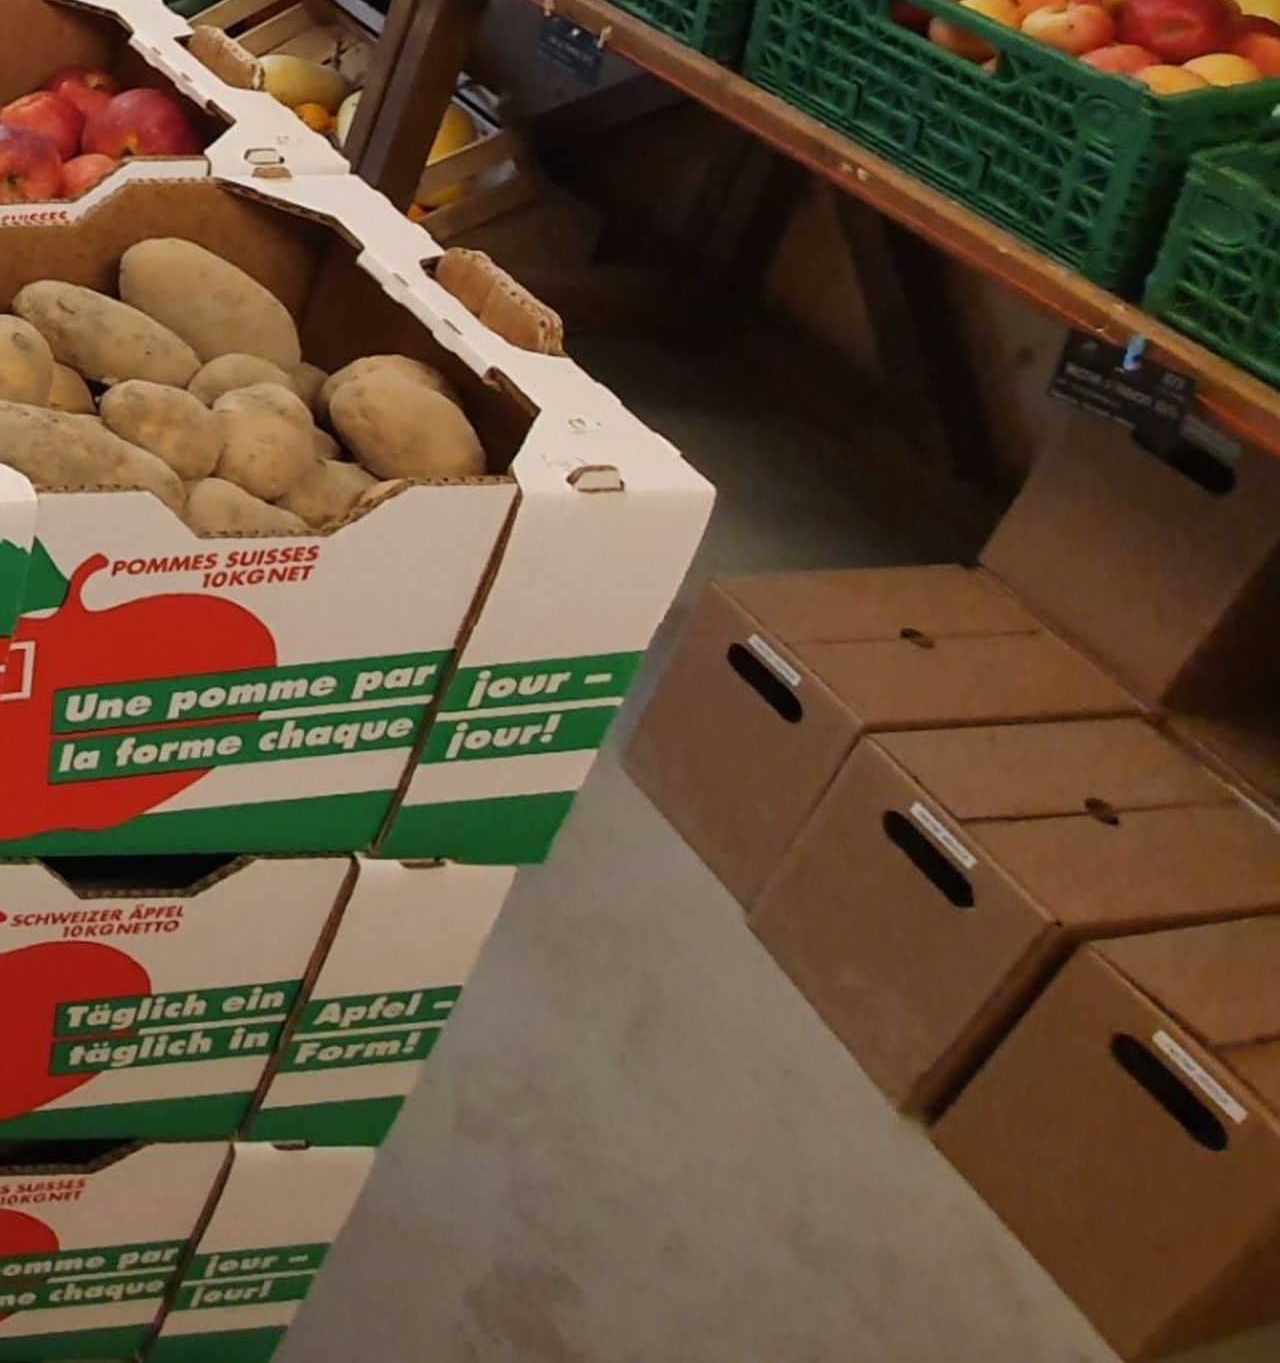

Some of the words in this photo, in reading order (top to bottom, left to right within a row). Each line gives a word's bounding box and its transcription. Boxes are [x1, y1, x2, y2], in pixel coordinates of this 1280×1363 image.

[112, 553, 218, 576] POMMES
[226, 546, 320, 568] SUISSES
[65, 694, 151, 723] Une
[167, 673, 338, 719] pomme
[352, 661, 437, 700] par
[468, 671, 571, 707] jour
[58, 744, 98, 773] la
[116, 734, 243, 767] forme
[259, 716, 414, 752] chaque
[445, 714, 559, 758] jour!
[11, 908, 122, 927] SCHWEIZER
[132, 902, 184, 921] ÄPFEL
[66, 994, 206, 1033] Täglich
[221, 986, 285, 1013] ein
[313, 992, 423, 1028] Apfel
[68, 1031, 212, 1070] täglich
[227, 1026, 269, 1051] in
[295, 1030, 420, 1064] Form!
[17, 1178, 86, 1194] SUISSES
[117, 1246, 179, 1270] par
[203, 1253, 279, 1278] jour
[48, 1278, 165, 1303] chaque
[190, 1281, 272, 1309] jour!
